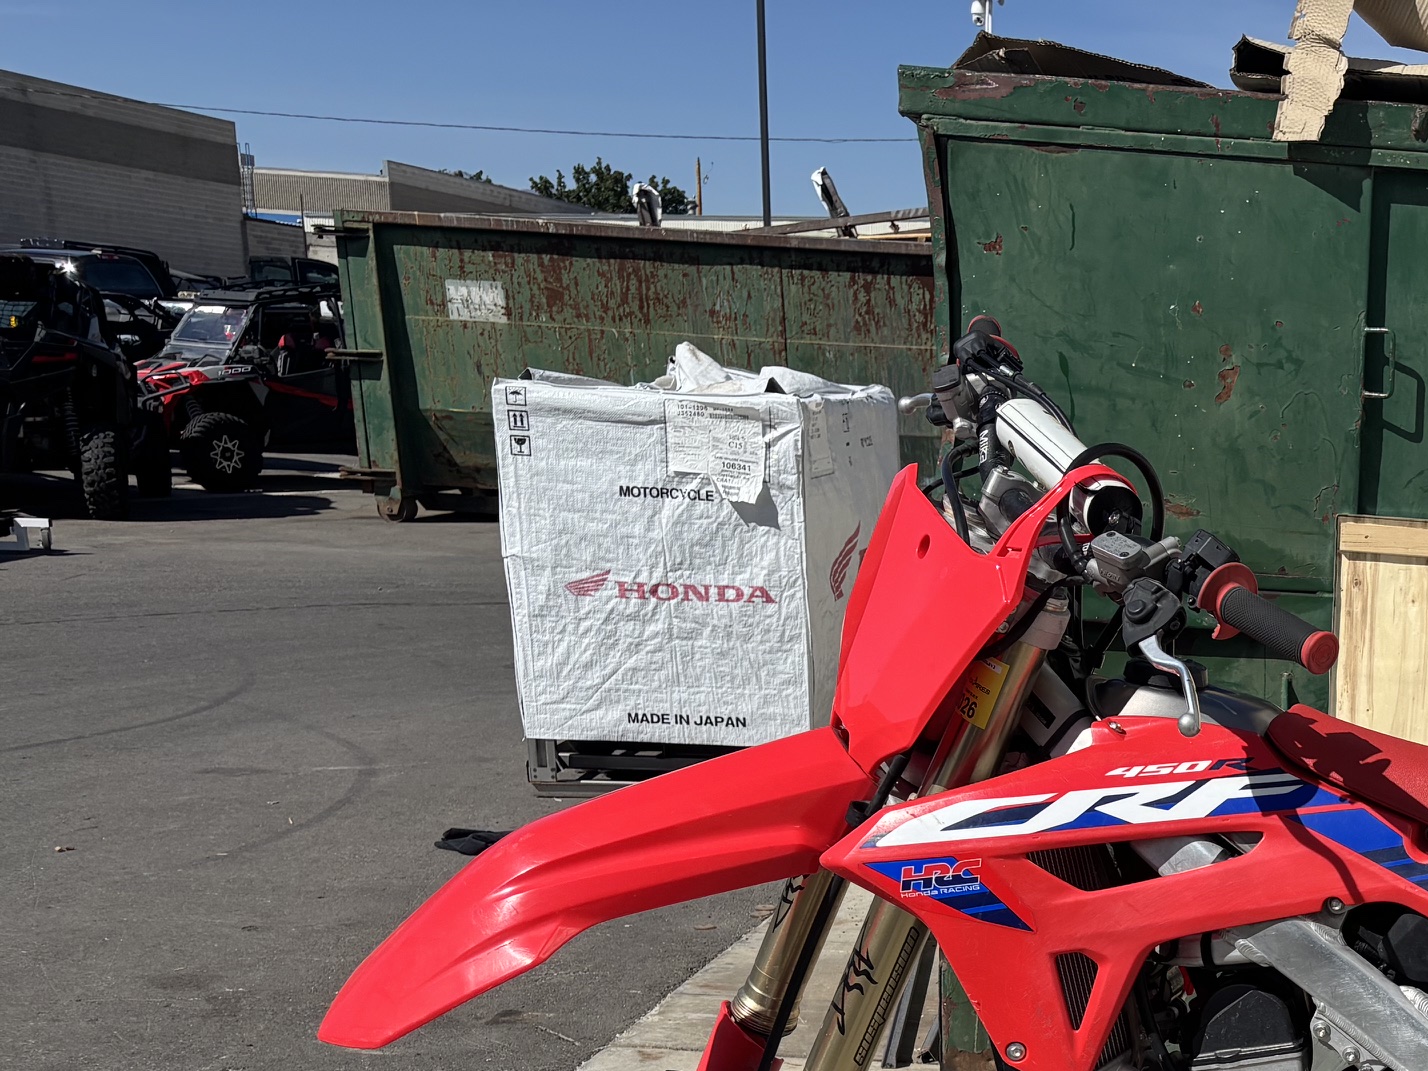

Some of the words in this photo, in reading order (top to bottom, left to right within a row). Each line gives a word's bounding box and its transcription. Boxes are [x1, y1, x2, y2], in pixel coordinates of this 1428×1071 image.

[218, 366, 252, 376] 1000
[619, 485, 715, 502] MOTORCYCLE
[616, 581, 777, 603] HONDA
[627, 711, 671, 726] MADE
[674, 714, 690, 727] IN
[694, 715, 747, 728] JAPAN
[1105, 757, 1255, 779] 450R
[876, 773, 1304, 847] CRF
[900, 858, 982, 892] HRC
[940, 885, 980, 894] RACING
